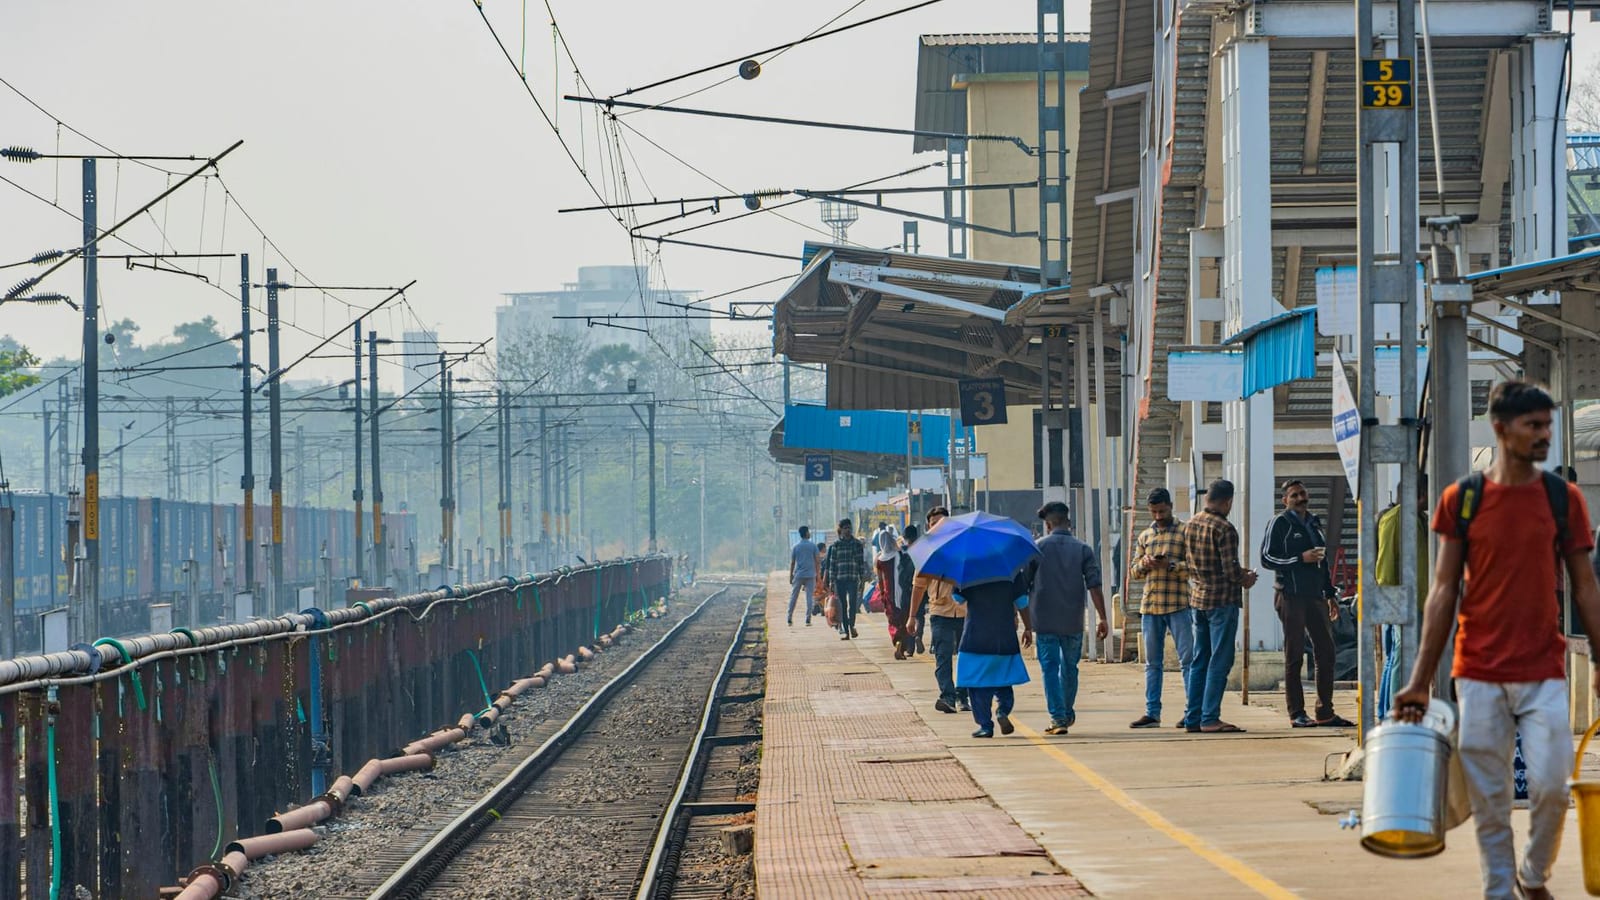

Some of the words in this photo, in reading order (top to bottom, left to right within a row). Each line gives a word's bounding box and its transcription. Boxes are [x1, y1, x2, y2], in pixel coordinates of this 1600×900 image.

[1379, 60, 1393, 81] 5
[1373, 85, 1403, 107] 39
[1047, 326, 1062, 337] 37
[973, 391, 995, 420] 3
[813, 463, 824, 478] 3
